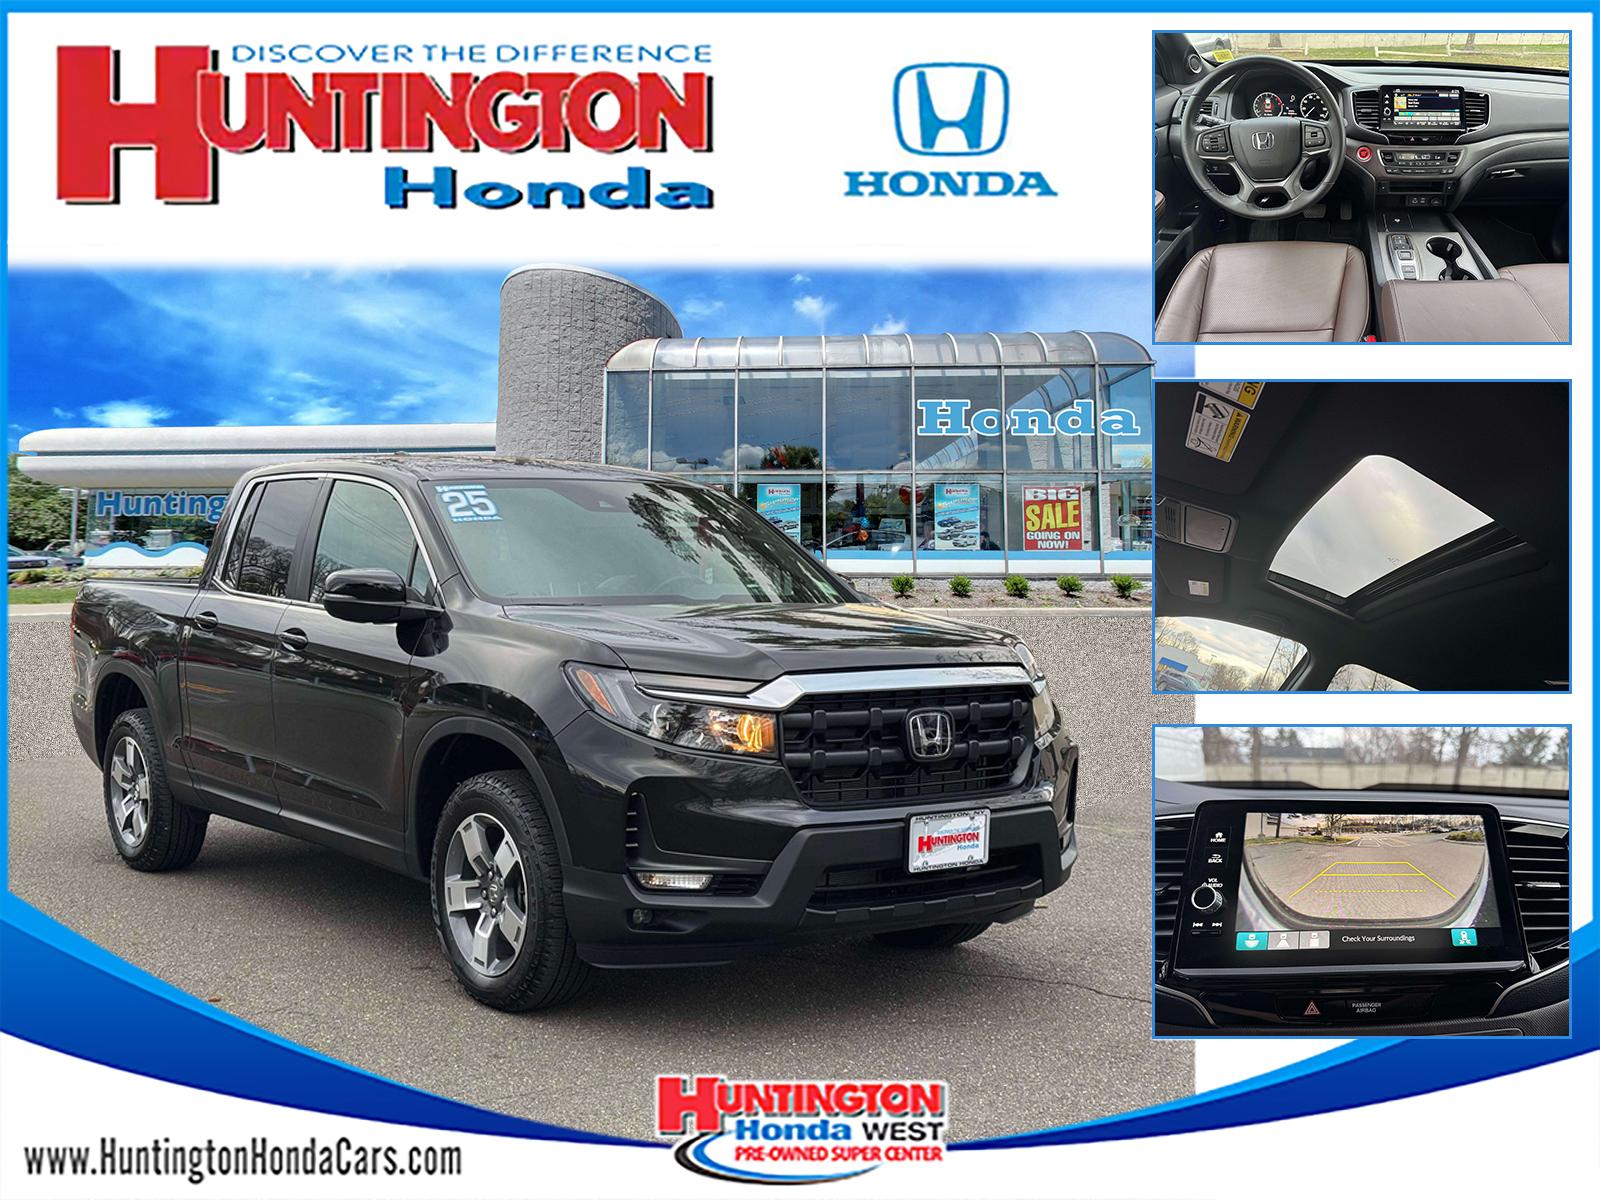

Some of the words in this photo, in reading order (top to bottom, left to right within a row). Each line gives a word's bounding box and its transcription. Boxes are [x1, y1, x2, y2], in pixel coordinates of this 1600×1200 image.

[917, 399, 1141, 437] Honda
[1025, 489, 1079, 500] BIG
[441, 490, 497, 517] 25
[1026, 501, 1079, 531] SALE
[1026, 531, 1060, 540] GOING
[1064, 531, 1080, 540] ON
[1037, 540, 1069, 549] NOW!
[917, 832, 979, 853] HUNTINGTON
[913, 861, 958, 872] HUNTINGTON
[1377, 934, 1415, 943] Surroundings
